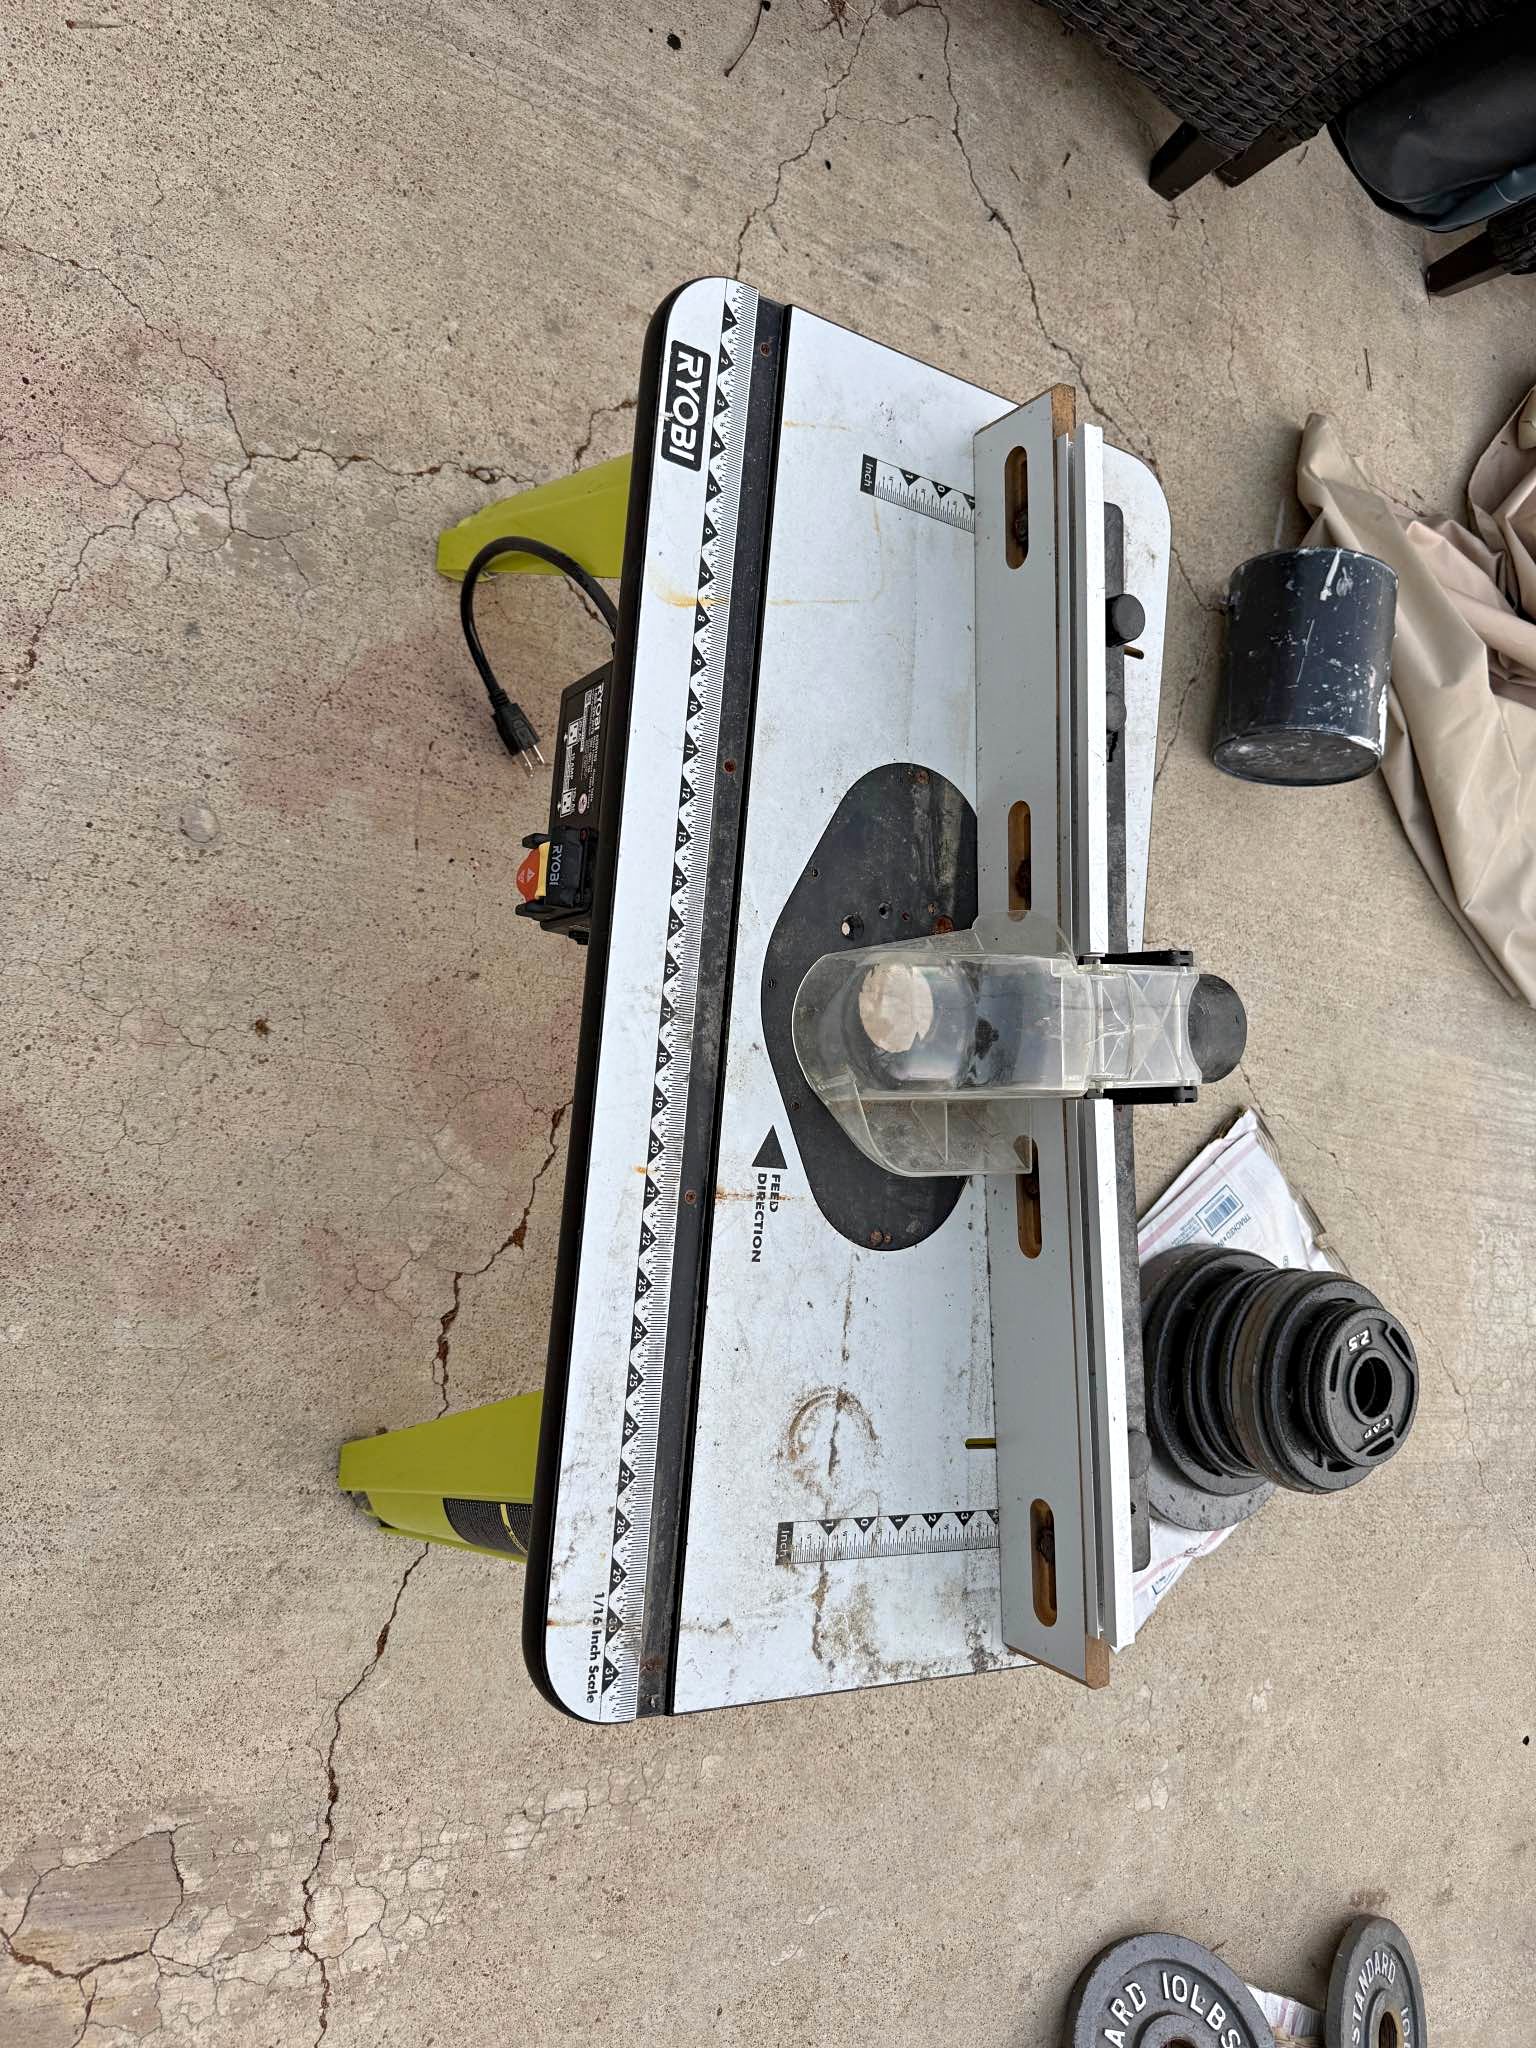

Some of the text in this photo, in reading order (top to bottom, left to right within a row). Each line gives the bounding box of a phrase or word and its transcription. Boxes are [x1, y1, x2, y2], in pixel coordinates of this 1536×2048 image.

[720, 357, 729, 365] 2
[669, 351, 704, 461] RYOBI
[716, 399, 725, 407] 3
[712, 440, 721, 449] 4
[864, 462, 874, 487] Inch
[708, 483, 718, 493] 5
[937, 485, 945, 493] 0
[705, 527, 713, 535] 6
[701, 571, 710, 579] 7
[697, 614, 706, 622] 8
[693, 658, 702, 666] 9
[594, 681, 605, 731] RYOBI
[689, 700, 698, 712] 10
[685, 744, 695, 754] 11
[682, 788, 691, 799] 12
[678, 831, 687, 843] 13
[549, 844, 563, 886] RYOBI
[674, 875, 683, 886] 14
[670, 919, 679, 930] 15
[666, 963, 675, 974] 16
[662, 1006, 671, 1019] 17
[658, 1051, 668, 1063] 18
[654, 1096, 664, 1109] 19
[650, 1140, 660, 1154] 20
[646, 1186, 656, 1198] 21
[769, 1174, 781, 1213] FEED
[751, 1173, 767, 1263] DIRECTION
[642, 1231, 651, 1246] 22
[637, 1278, 647, 1293] 23
[633, 1325, 643, 1340] 24
[1348, 1329, 1370, 1352] 2.5
[629, 1372, 639, 1387] 25
[624, 1421, 634, 1436] 26
[1364, 1418, 1389, 1439] CAP
[620, 1469, 630, 1484] 27
[616, 1518, 626, 1534] 28
[860, 1518, 870, 1527] 0
[928, 1514, 937, 1522] 2
[780, 1530, 790, 1557] Inch
[612, 1568, 622, 1583] 29
[586, 1592, 605, 1703] 1/16 Inch Scale
[604, 1667, 614, 1681] 31
[1352, 1952, 1396, 2045] STANDARD
